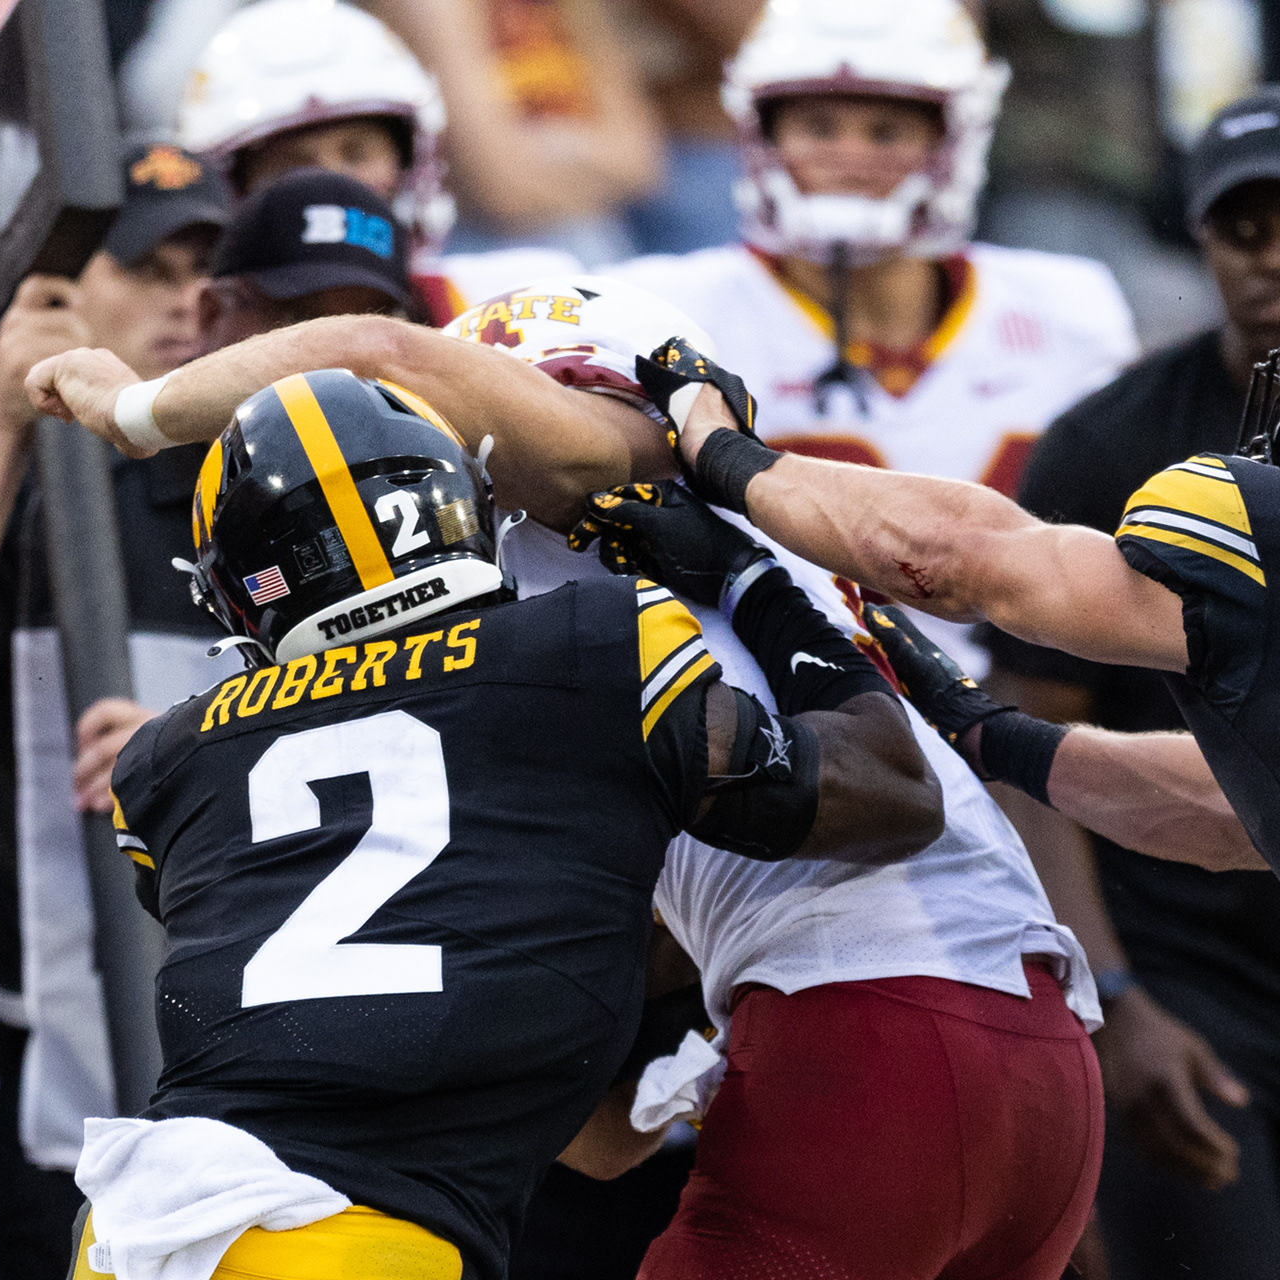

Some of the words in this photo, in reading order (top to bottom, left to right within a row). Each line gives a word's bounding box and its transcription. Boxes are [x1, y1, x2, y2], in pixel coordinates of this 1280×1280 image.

[453, 295, 581, 338] TATE
[374, 489, 431, 558] 2
[317, 577, 450, 640] TOGETHER
[200, 618, 481, 732] ROBERTS
[241, 709, 450, 1008] 2
